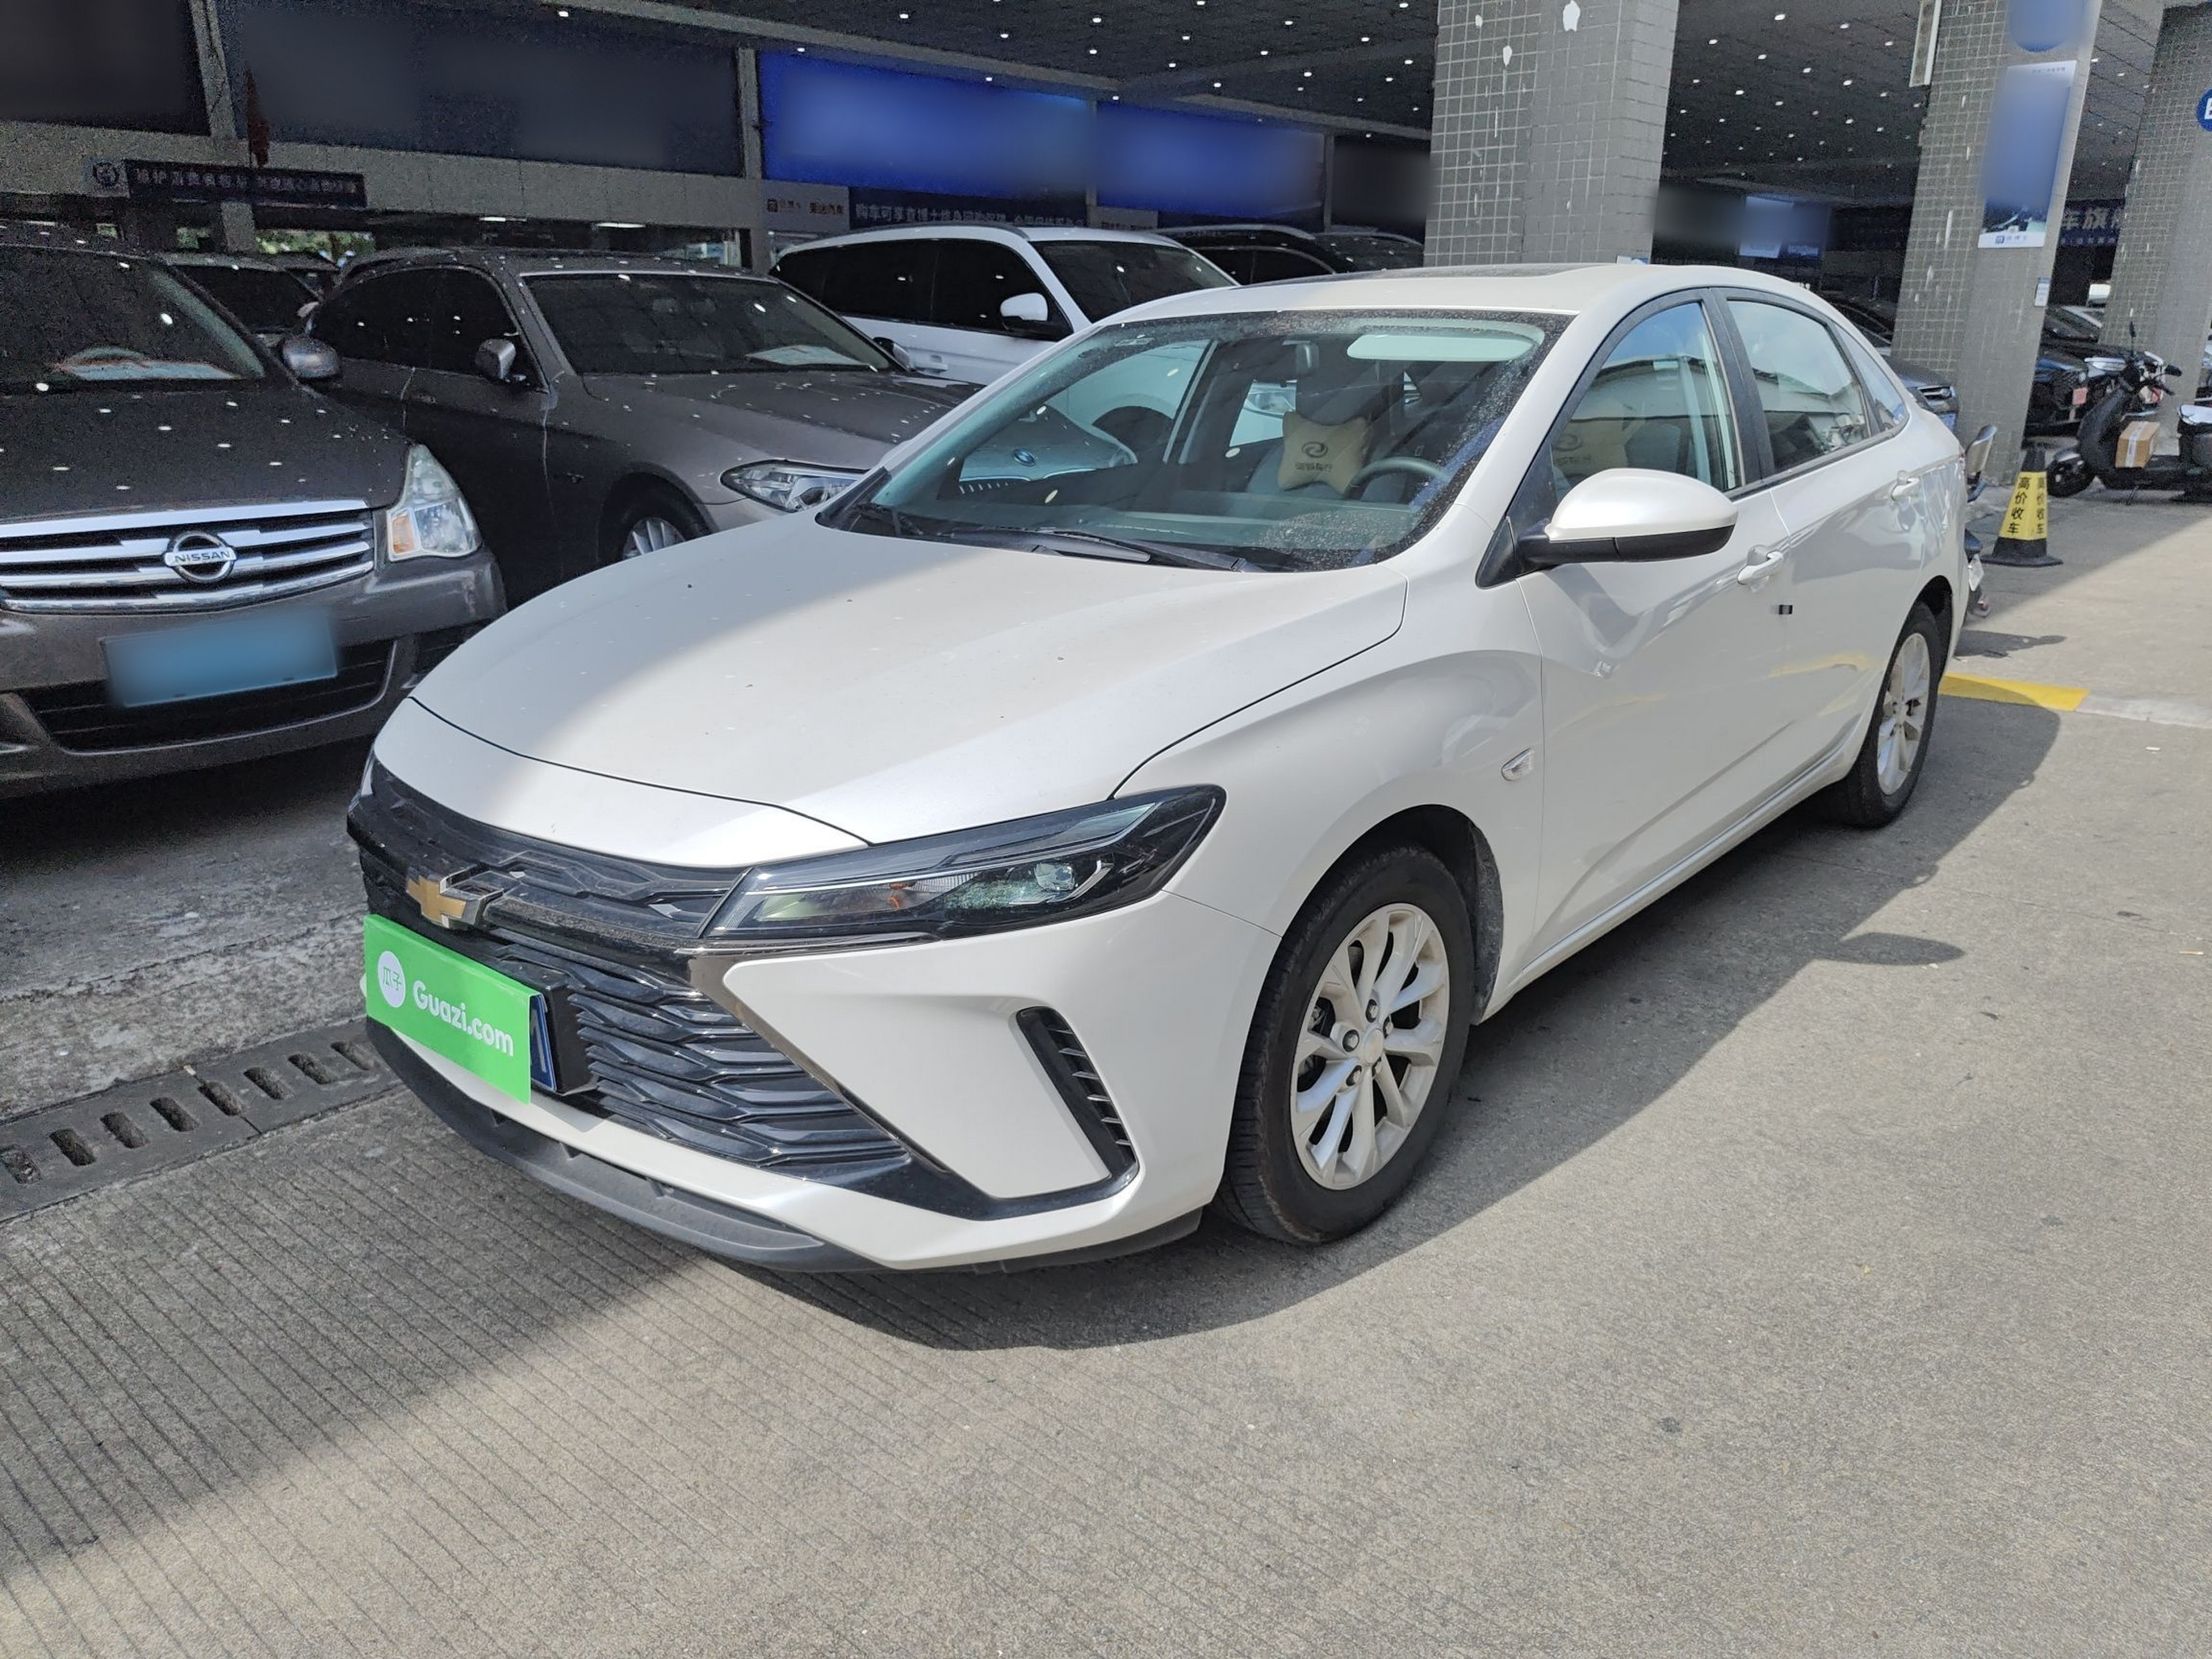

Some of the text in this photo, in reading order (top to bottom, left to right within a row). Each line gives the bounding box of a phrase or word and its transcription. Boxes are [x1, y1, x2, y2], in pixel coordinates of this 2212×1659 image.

[2008, 477, 2031, 534] 高价收车
[2036, 478, 2045, 533] 高价收车
[175, 551, 230, 562] NISSAN
[383, 967, 402, 991] 瓜子
[414, 980, 513, 1056] Guazi.com
